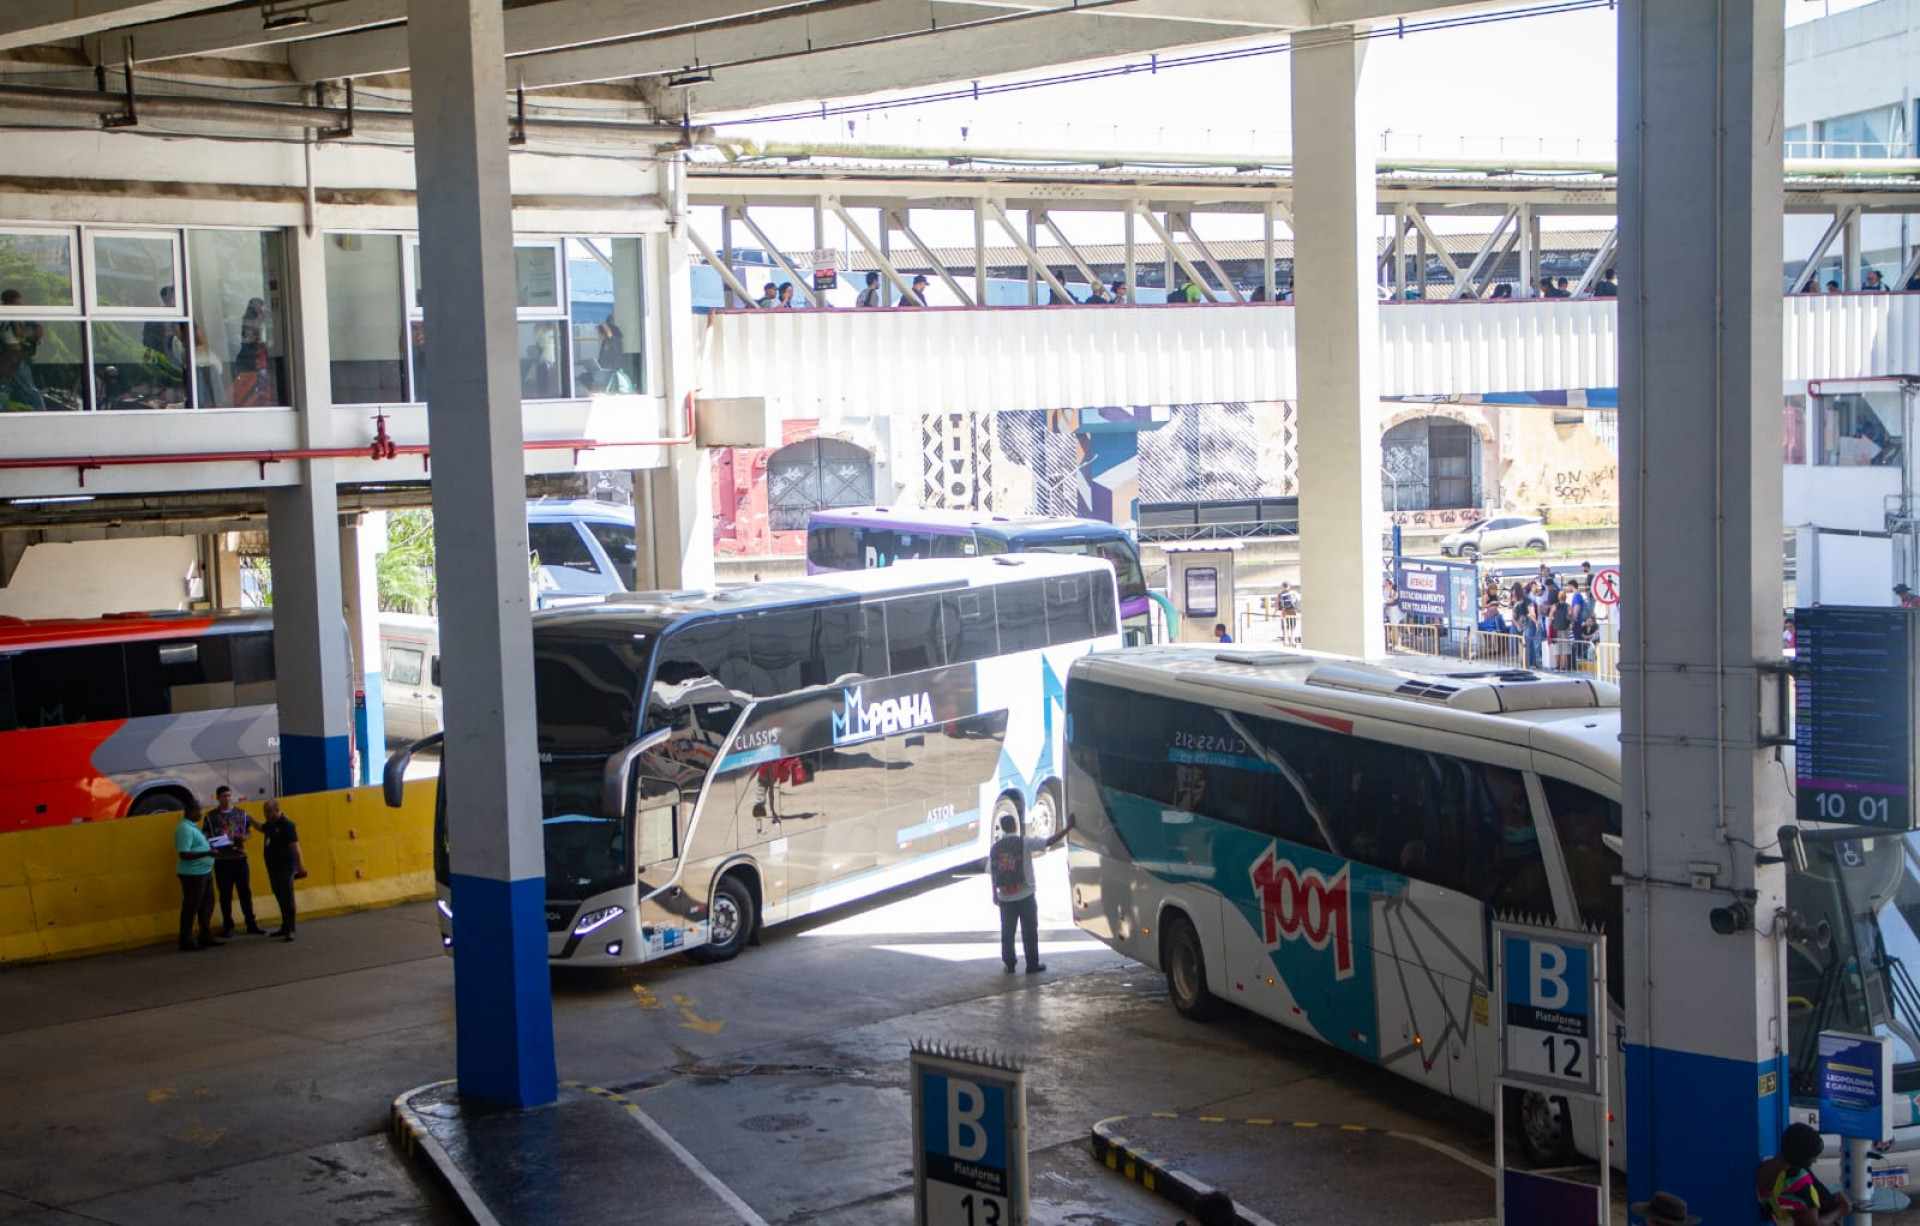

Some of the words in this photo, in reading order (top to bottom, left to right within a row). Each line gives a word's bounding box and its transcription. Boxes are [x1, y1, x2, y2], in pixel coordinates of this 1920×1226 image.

[868, 691, 934, 736] PENHA
[735, 728, 779, 751] CLASSIS
[926, 803, 955, 824] ASTOR
[1816, 793, 1846, 818] 10
[1859, 796, 1889, 822] 01
[1249, 837, 1355, 981] 1001
[1529, 940, 1570, 1010] B
[1535, 1009, 1582, 1028] Plataforma
[1542, 1034, 1582, 1078] 12
[947, 1076, 988, 1162] B
[953, 1161, 1001, 1184] Plataforma
[961, 1194, 1001, 1226] 13
